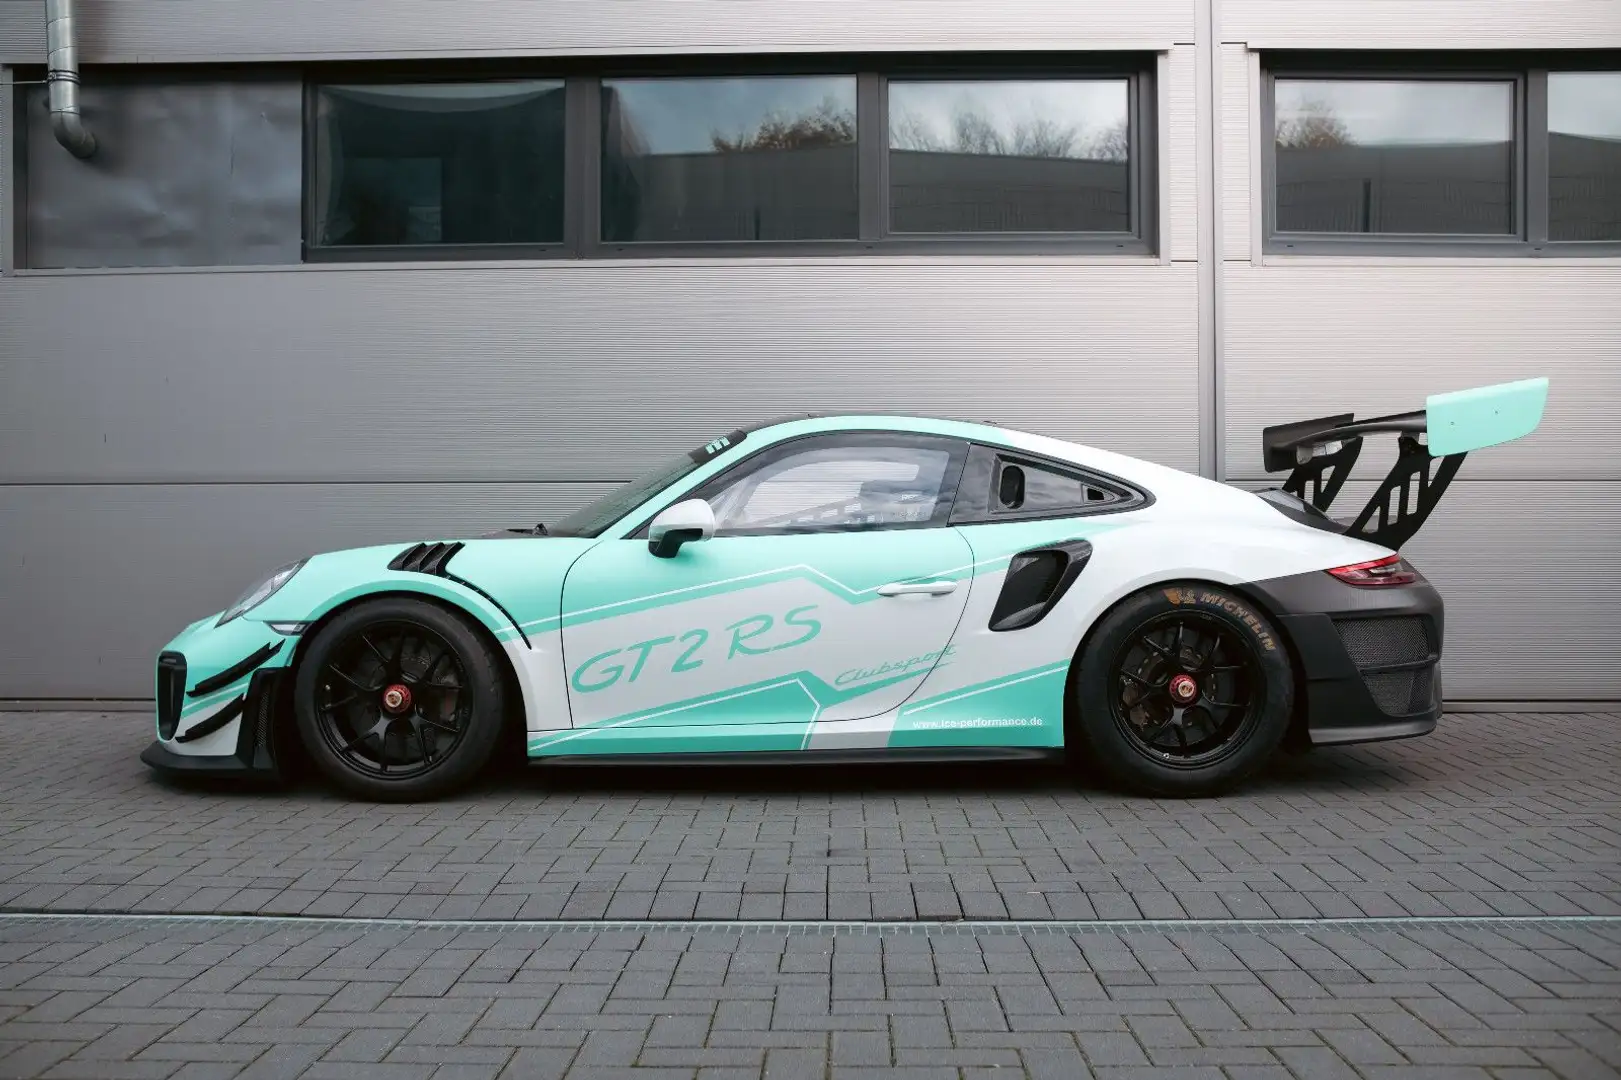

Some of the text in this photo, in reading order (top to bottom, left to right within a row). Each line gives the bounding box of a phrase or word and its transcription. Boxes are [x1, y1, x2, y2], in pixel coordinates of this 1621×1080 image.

[1200, 591, 1277, 651] MICHELIN
[572, 605, 822, 693] GT2 RS
[835, 643, 958, 685] Clubsport
[912, 716, 1043, 729] www.ice-performance.de
